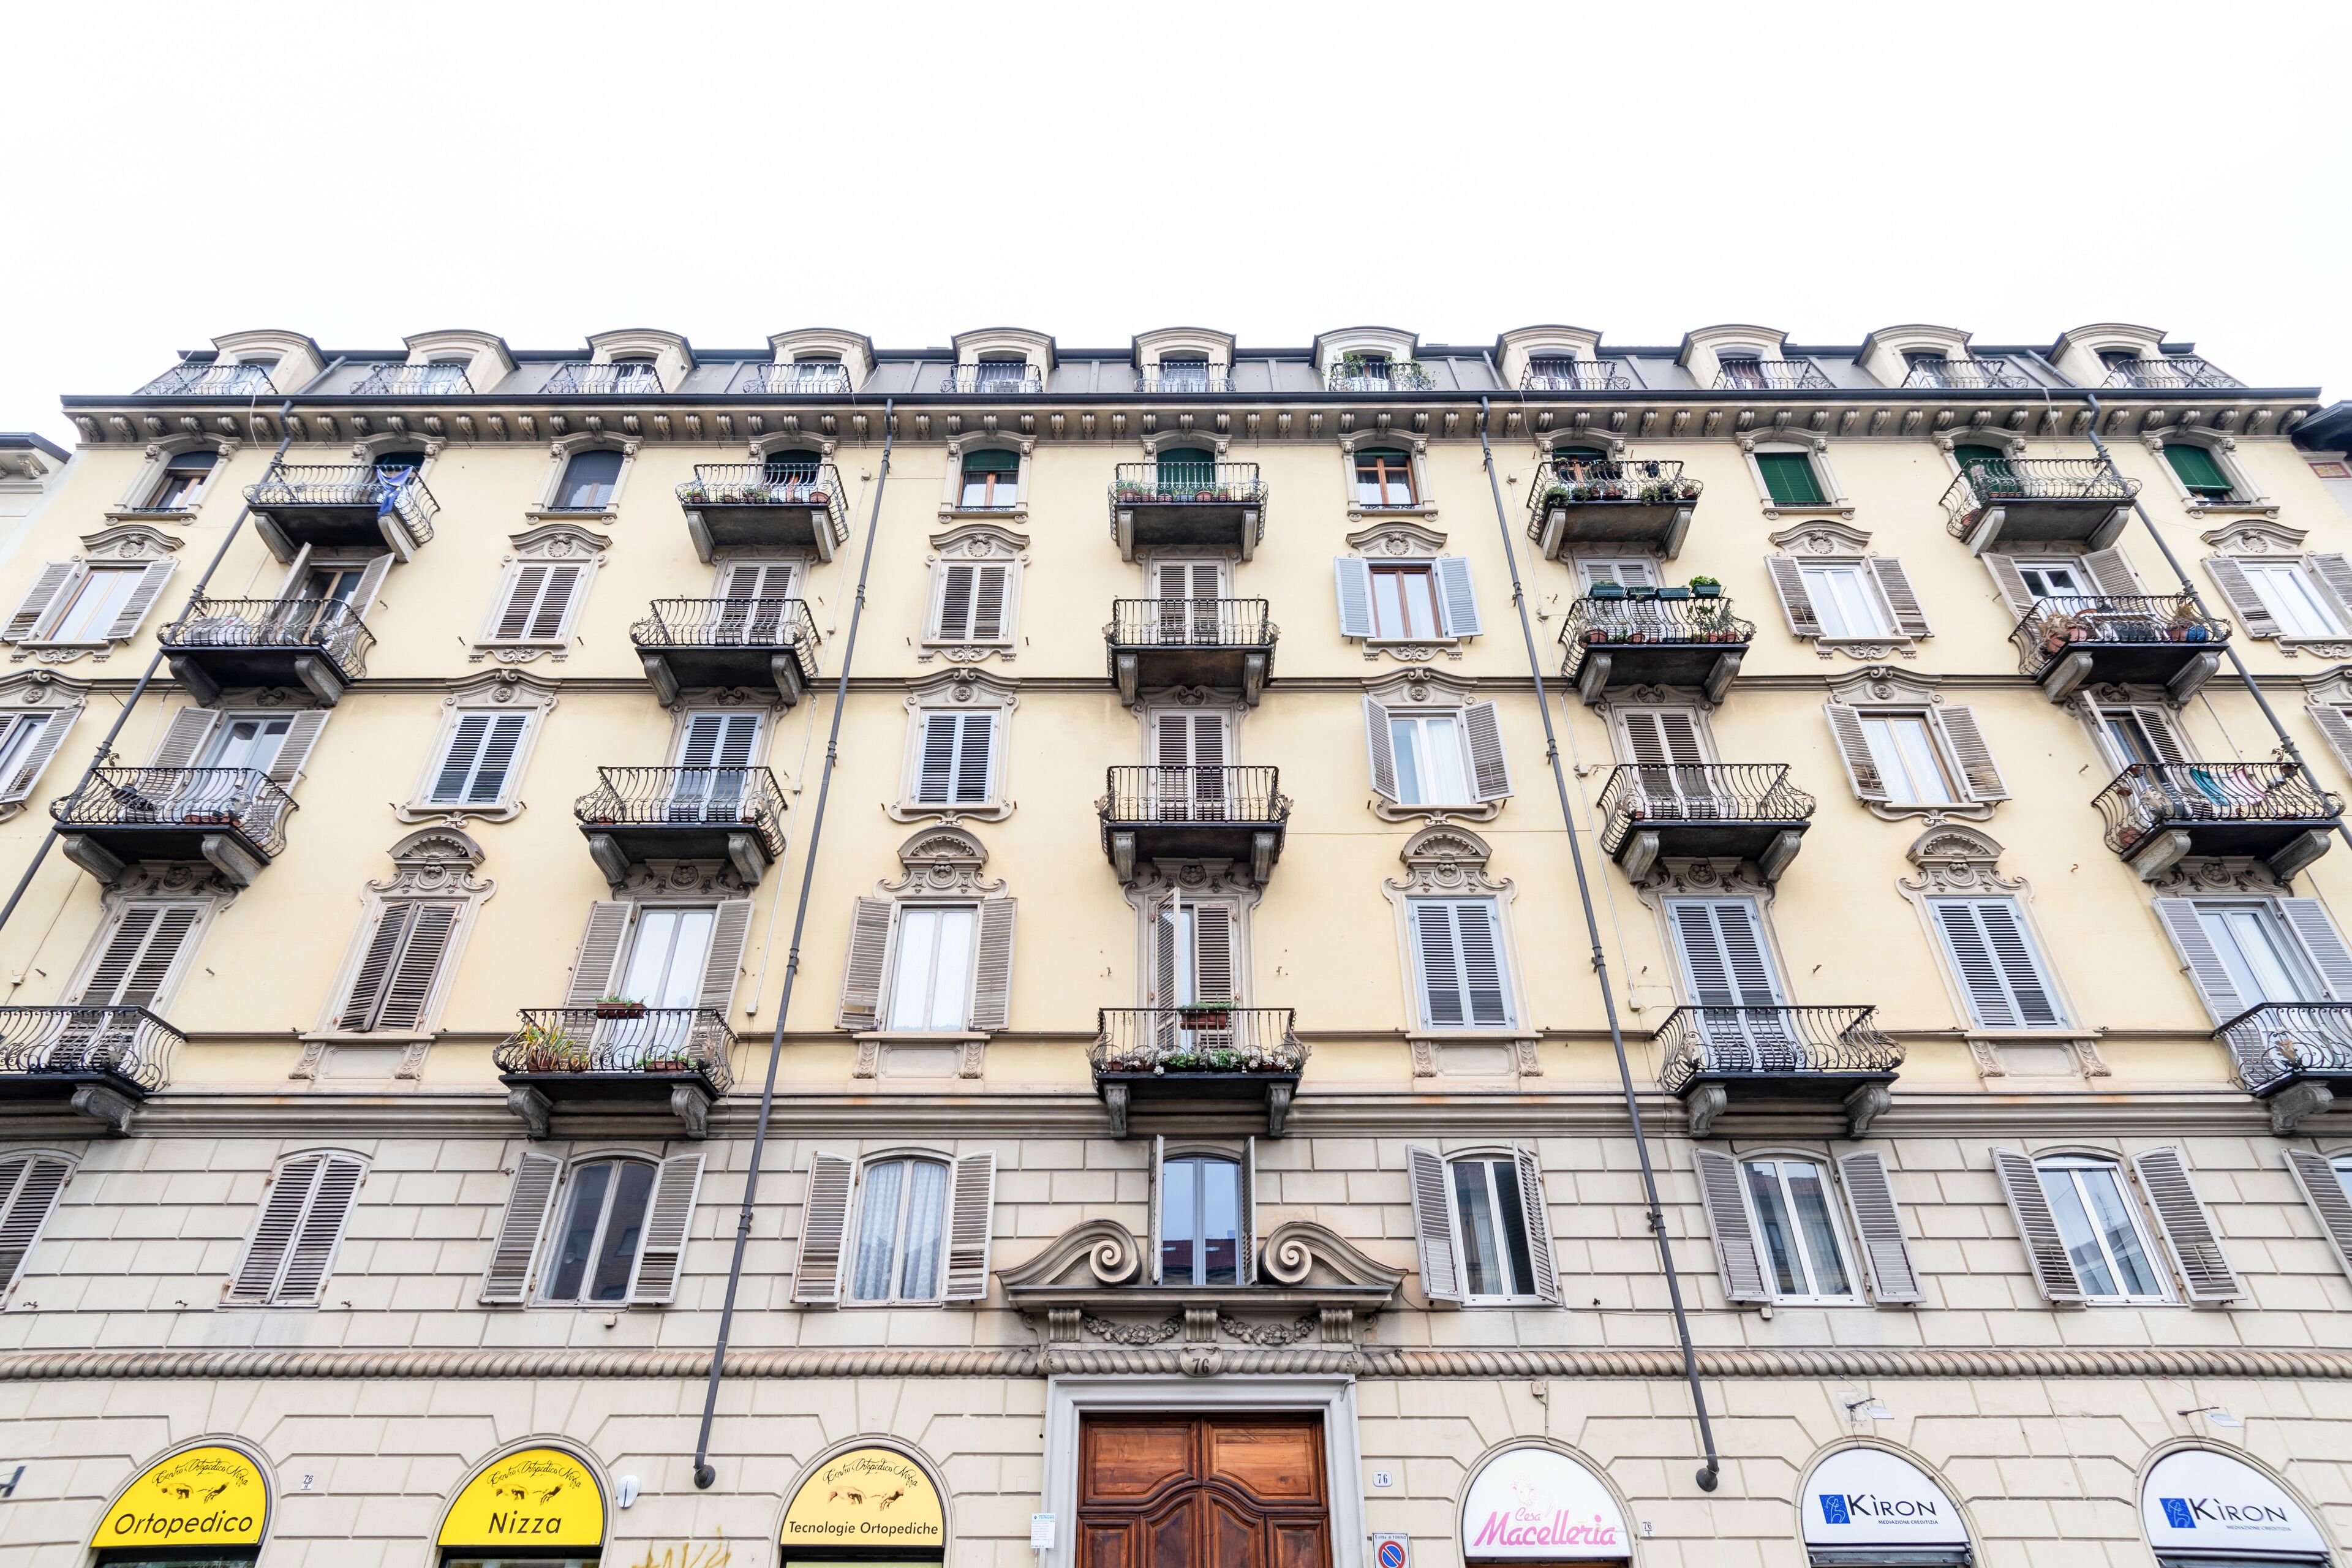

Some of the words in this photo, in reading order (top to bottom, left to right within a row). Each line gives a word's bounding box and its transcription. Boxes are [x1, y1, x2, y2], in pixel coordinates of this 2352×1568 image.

[1192, 1357, 1210, 1373] 76
[152, 1464, 183, 1487] Centro
[185, 1458, 229, 1476] Ortopedico
[226, 1465, 249, 1487] Nizza
[487, 1466, 516, 1487] Centro
[518, 1460, 561, 1478] Ortopedico
[558, 1467, 581, 1489] Nizza
[823, 1463, 851, 1485] Centro
[851, 1458, 895, 1476] Ortopedico
[893, 1465, 918, 1488] Nizza
[1377, 1474, 1388, 1484] 76
[115, 1510, 253, 1538] Ortopedico
[488, 1510, 562, 1534] Nizza
[1515, 1507, 1541, 1521] Cesa
[789, 1521, 856, 1536] Tecnologie
[860, 1521, 938, 1537] Ortopediche
[1472, 1509, 1616, 1547] Macelleria
